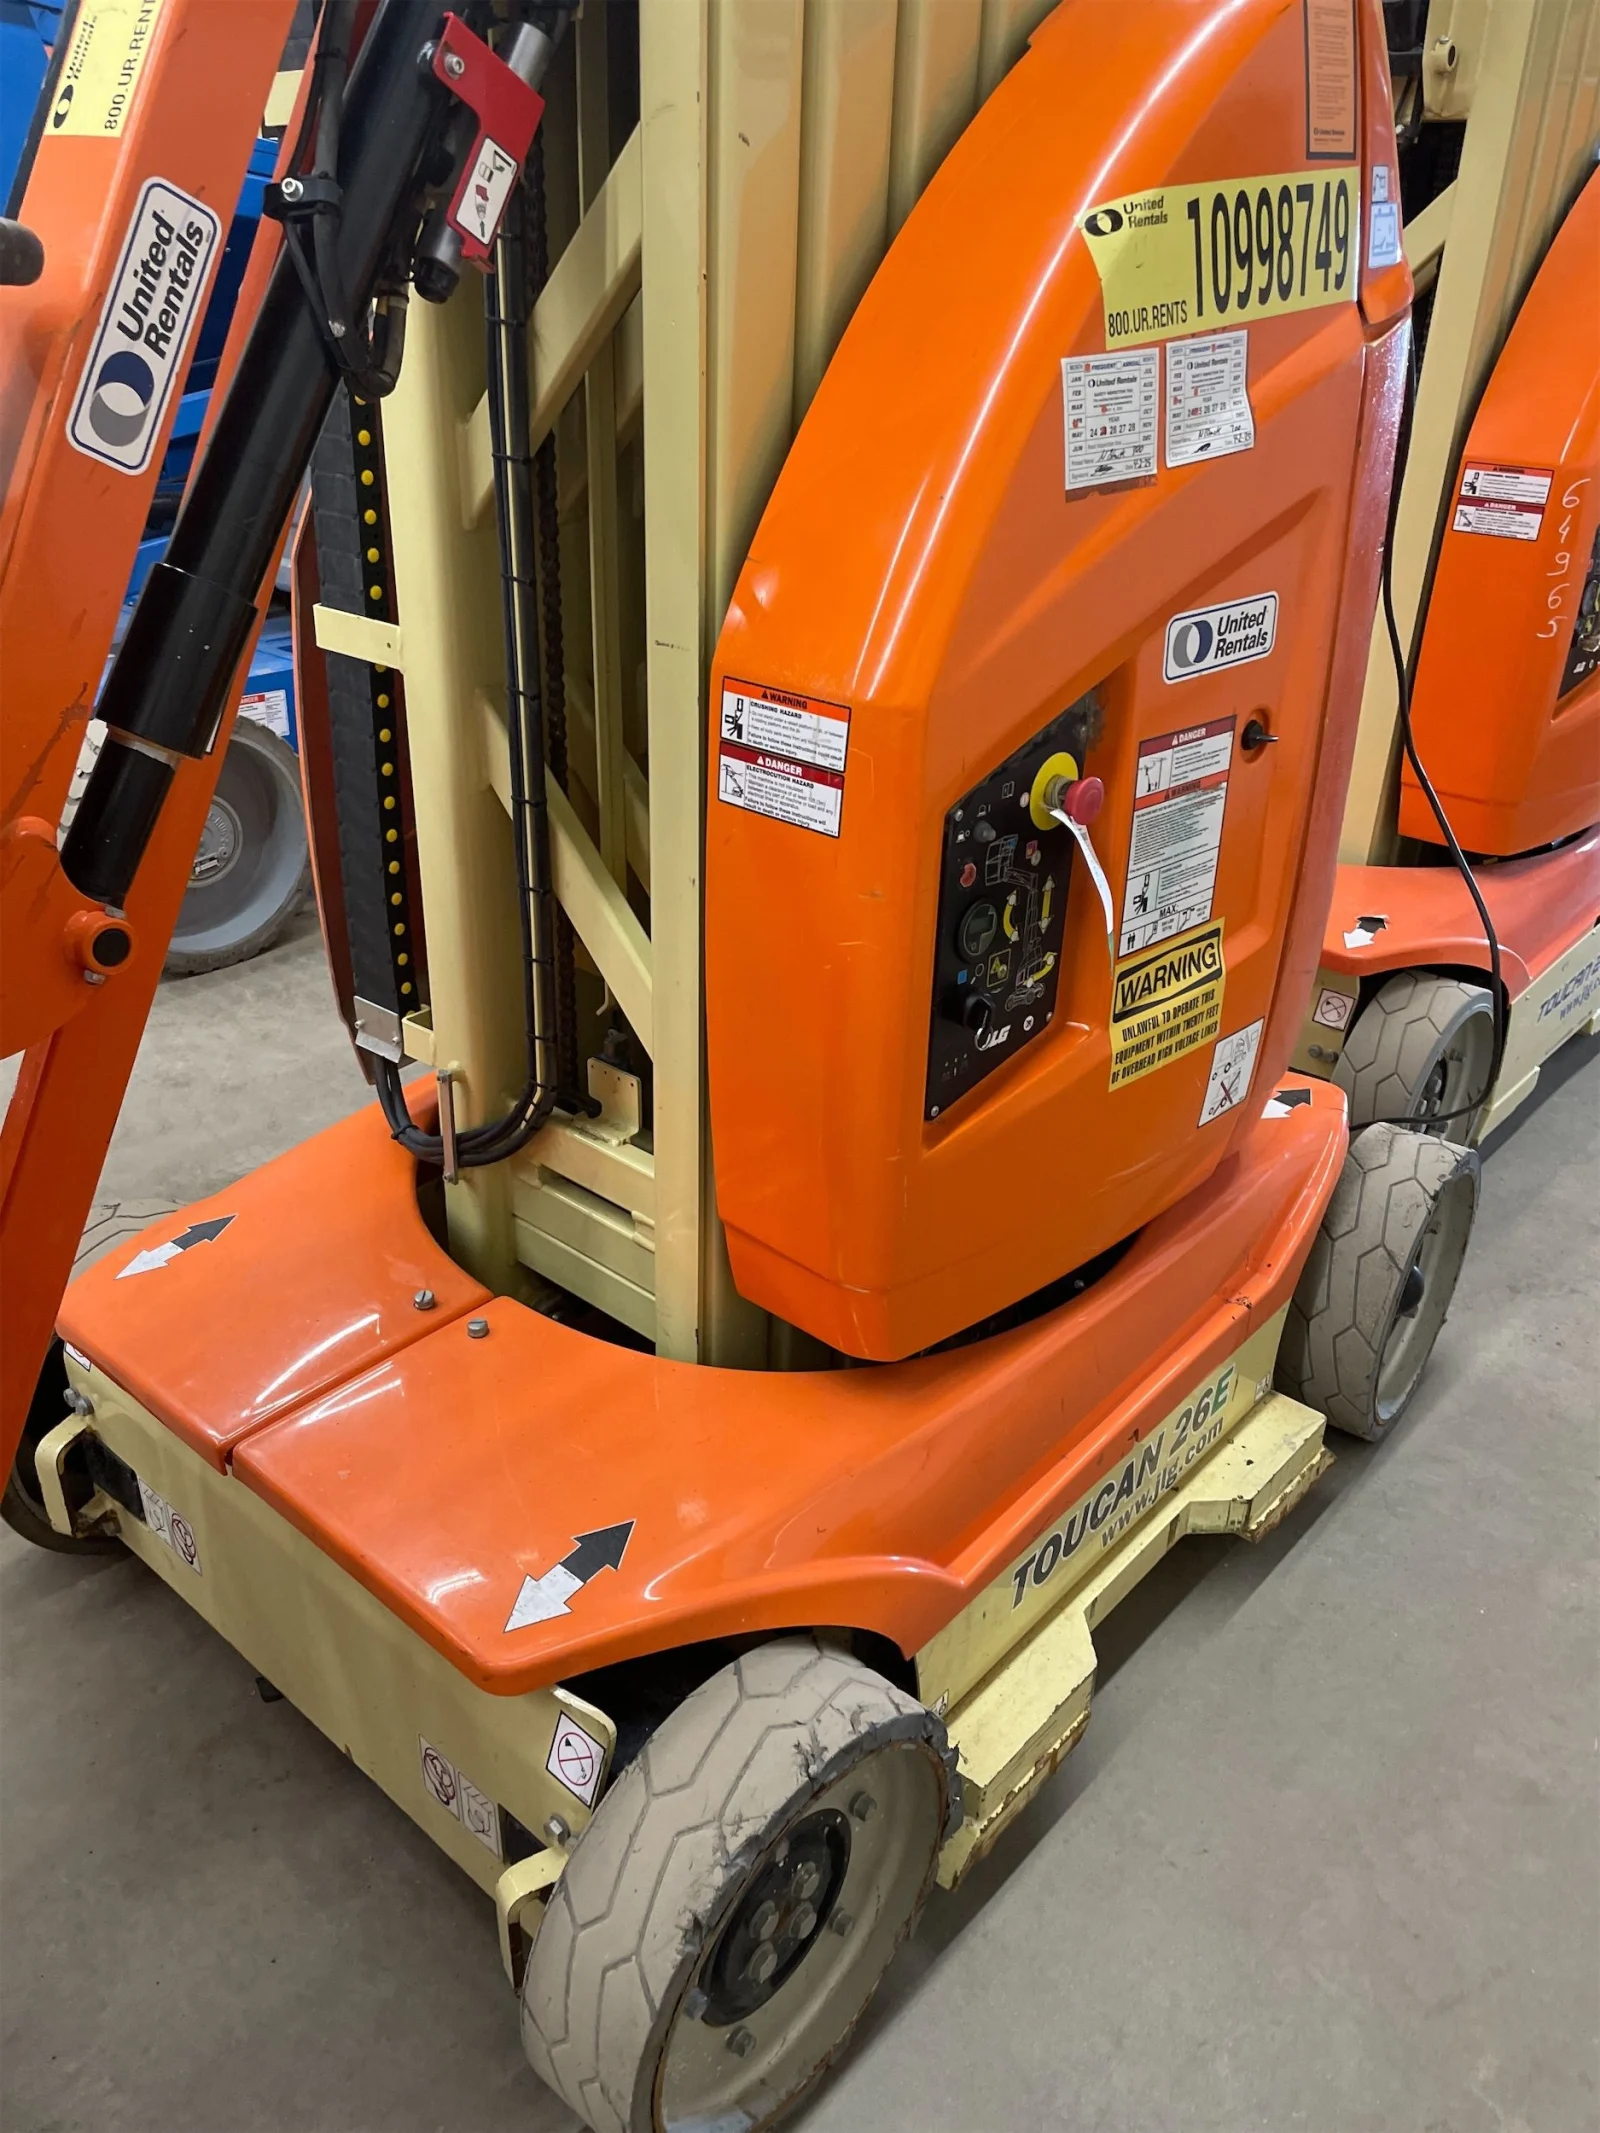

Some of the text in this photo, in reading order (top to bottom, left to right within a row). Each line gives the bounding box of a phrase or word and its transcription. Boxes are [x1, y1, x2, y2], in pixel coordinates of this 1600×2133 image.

[67, 20, 88, 80] United
[74, 16, 97, 80] Rentals
[1123, 196, 1164, 215] United
[1128, 211, 1168, 228] Rentals
[1187, 178, 1349, 318] 10998749
[117, 210, 175, 342] United
[144, 220, 204, 358] Rentals
[1108, 300, 1188, 337] 800.UR.RENTS
[1096, 375, 1138, 388] United Rentals
[1090, 428, 1098, 438] 24
[1118, 424, 1126, 434] 27
[1216, 604, 1268, 636] United
[1214, 628, 1268, 660] Rentals
[750, 701, 802, 718] CRUSHING HAZARD
[769, 692, 807, 709] WARNING
[1179, 728, 1206, 743] DANGER
[746, 764, 814, 788] ELECTROCUTION HAZARD
[765, 757, 802, 776] DANGER
[1120, 942, 1217, 1008] WARNING
[1122, 988, 1216, 1042] UNLAWFUL TO OPERATE THIS
[1111, 1020, 1218, 1084] OF OVERHEAD HIGH VOLTAGE LINES
[1114, 1003, 1220, 1066] EQUIPMENT WITHIN TWENTY FEET
[1012, 1364, 1236, 1610] TOUCAN 26E
[1100, 1416, 1224, 1550] www.jlg.com
